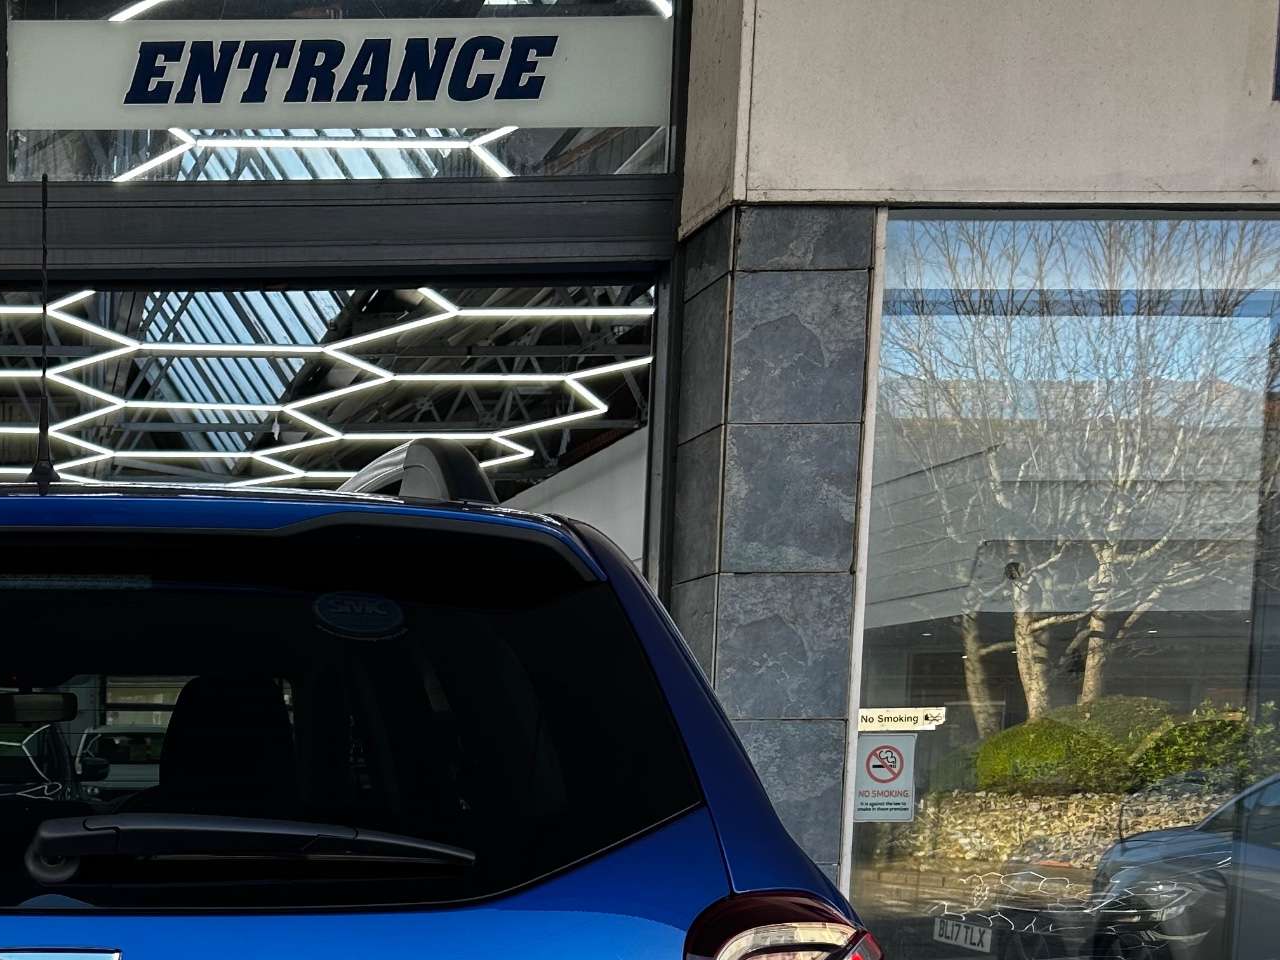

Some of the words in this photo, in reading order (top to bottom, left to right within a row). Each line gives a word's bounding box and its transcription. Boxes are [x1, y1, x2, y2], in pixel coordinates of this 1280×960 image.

[123, 35, 559, 104] ENTRANCE
[860, 715, 875, 724] No
[878, 714, 919, 725] Smoking
[858, 790, 870, 798] NO
[871, 790, 910, 798] SMOKING
[938, 919, 961, 941] BL17
[963, 925, 986, 948] TLX
